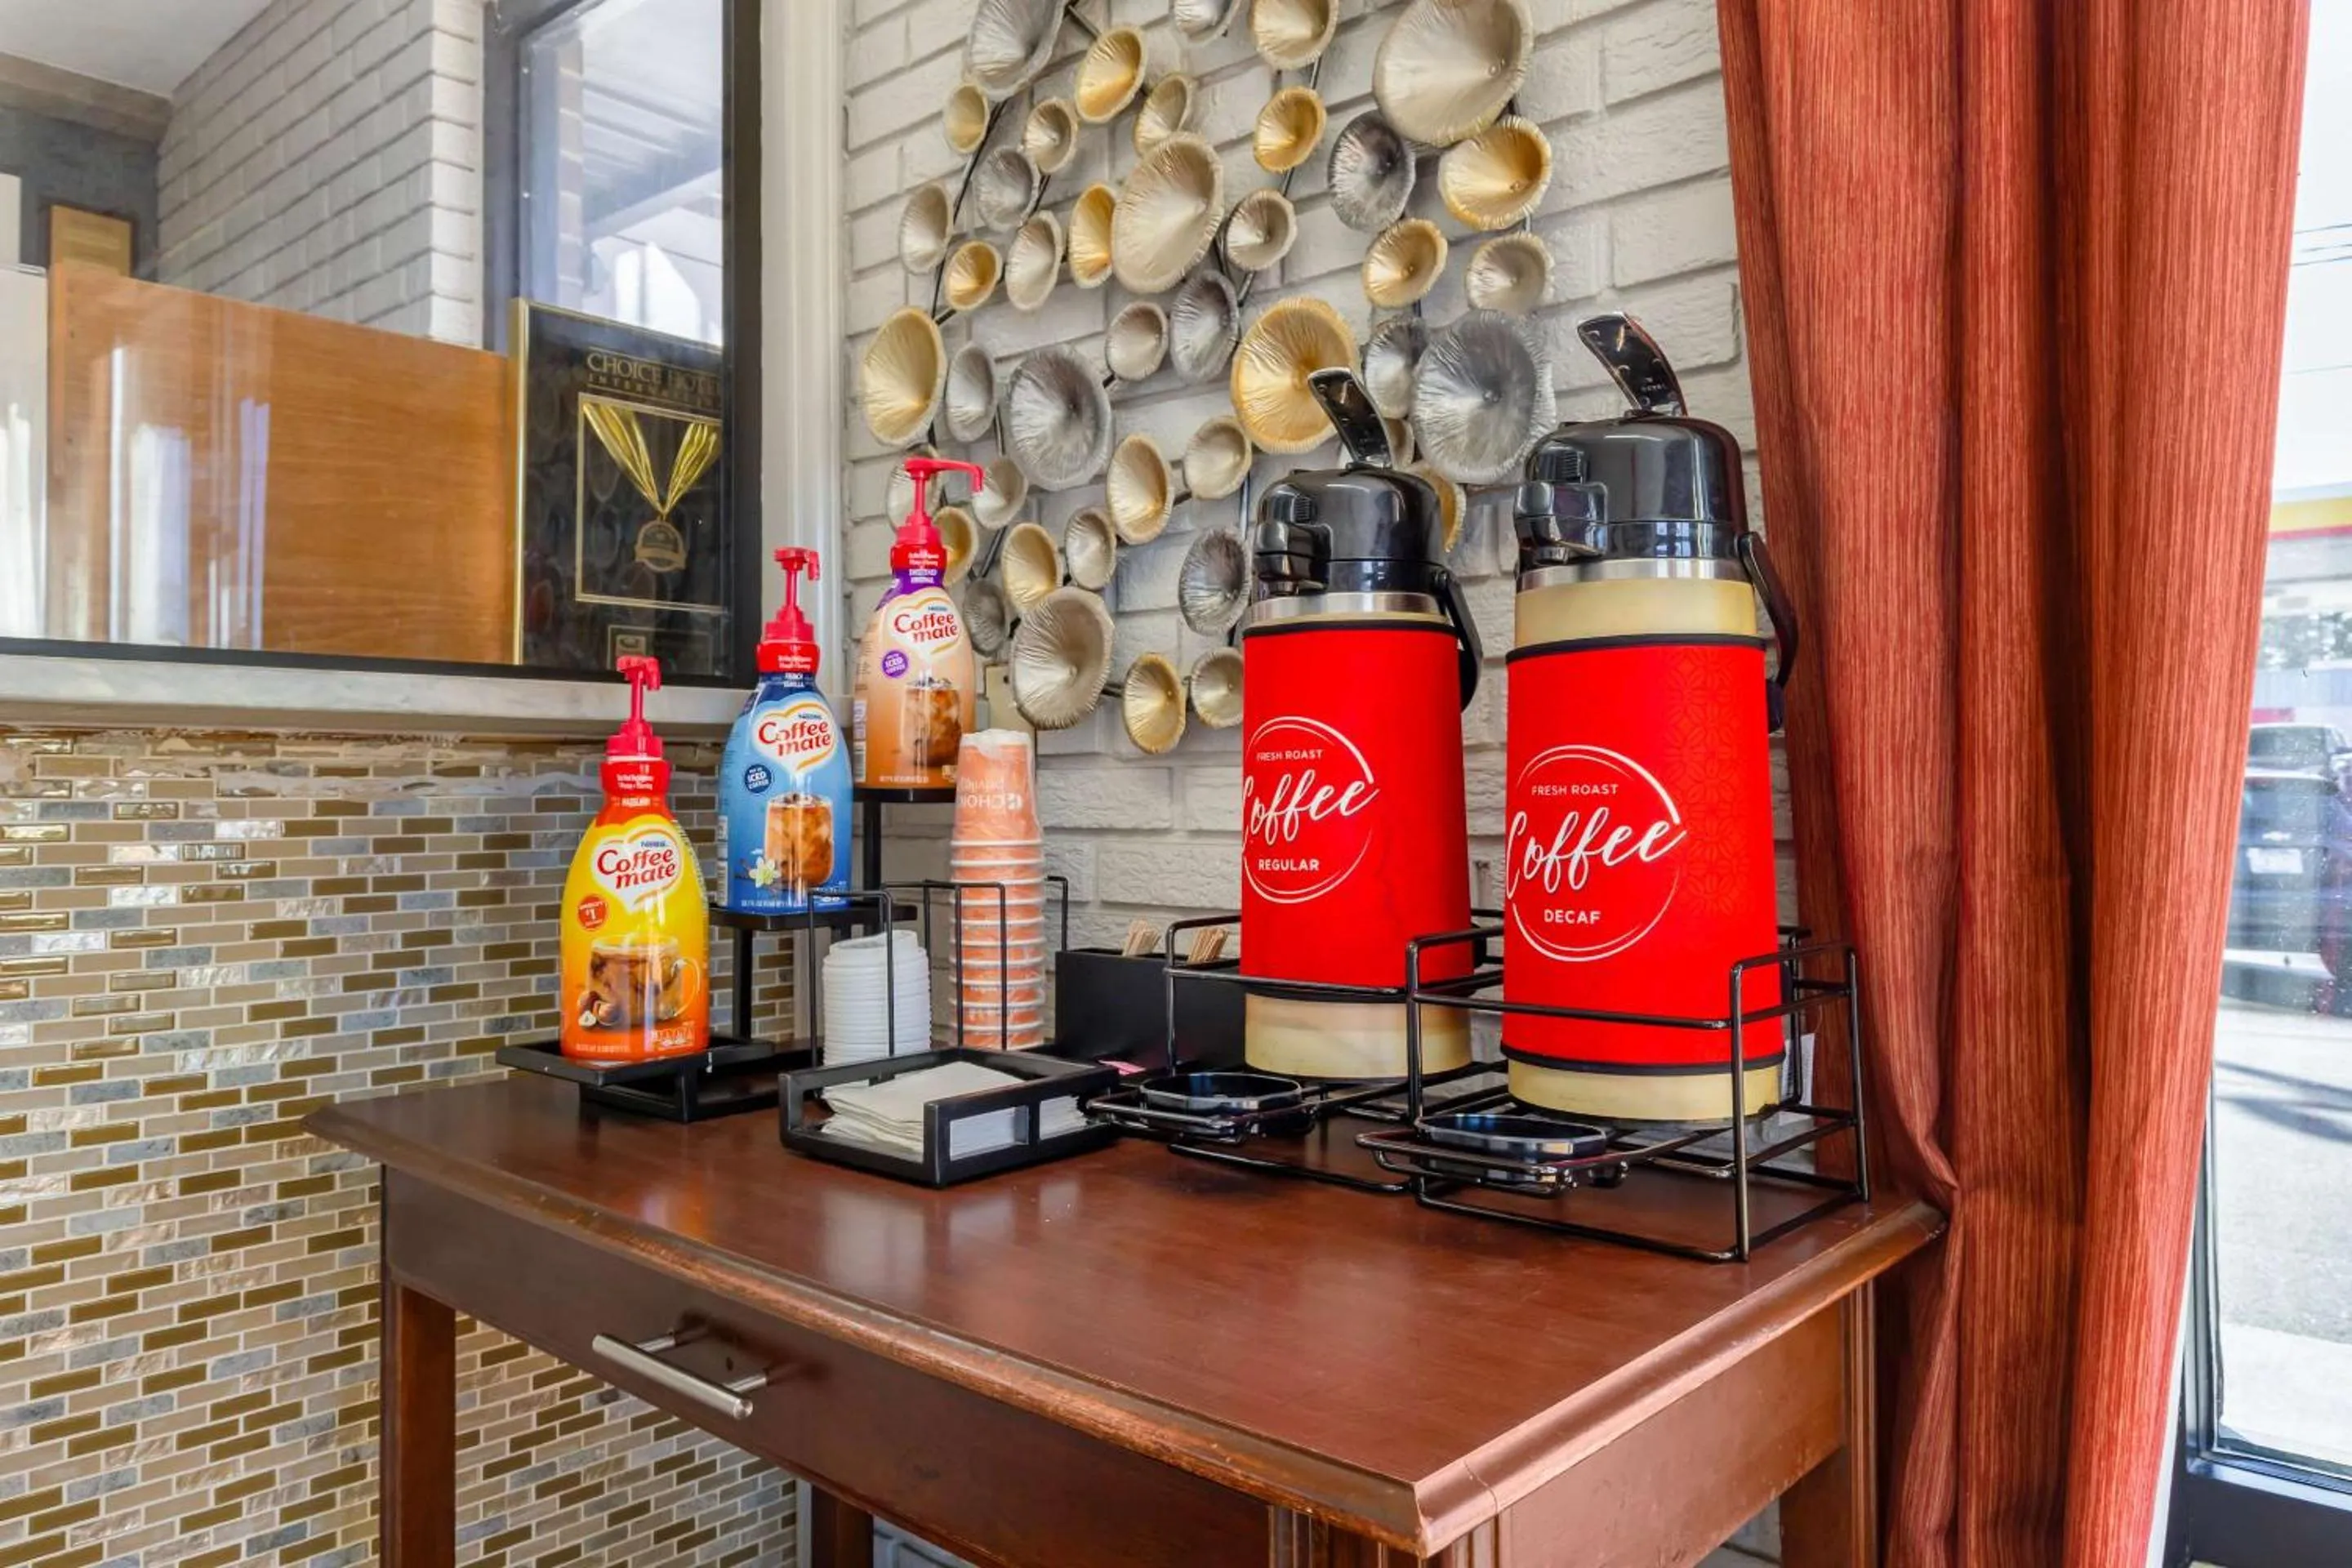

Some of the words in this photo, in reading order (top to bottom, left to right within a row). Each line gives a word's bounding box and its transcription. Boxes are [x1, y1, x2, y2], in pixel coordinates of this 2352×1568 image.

[587, 353, 662, 385] CHOICE
[894, 613, 955, 633] Coffee
[912, 624, 958, 643] mate
[758, 720, 828, 745] Coffee
[777, 733, 831, 757] mate
[1256, 752, 1283, 761] FRESH
[1285, 749, 1324, 760] ROAST
[1531, 785, 1567, 795] FRESH
[1570, 783, 1619, 795] ROAST
[597, 849, 674, 875] Coffee
[1507, 807, 1687, 899] Coffee
[616, 862, 676, 889] mate
[1258, 858, 1320, 871] REGULAR
[1544, 908, 1601, 924] DECAF
